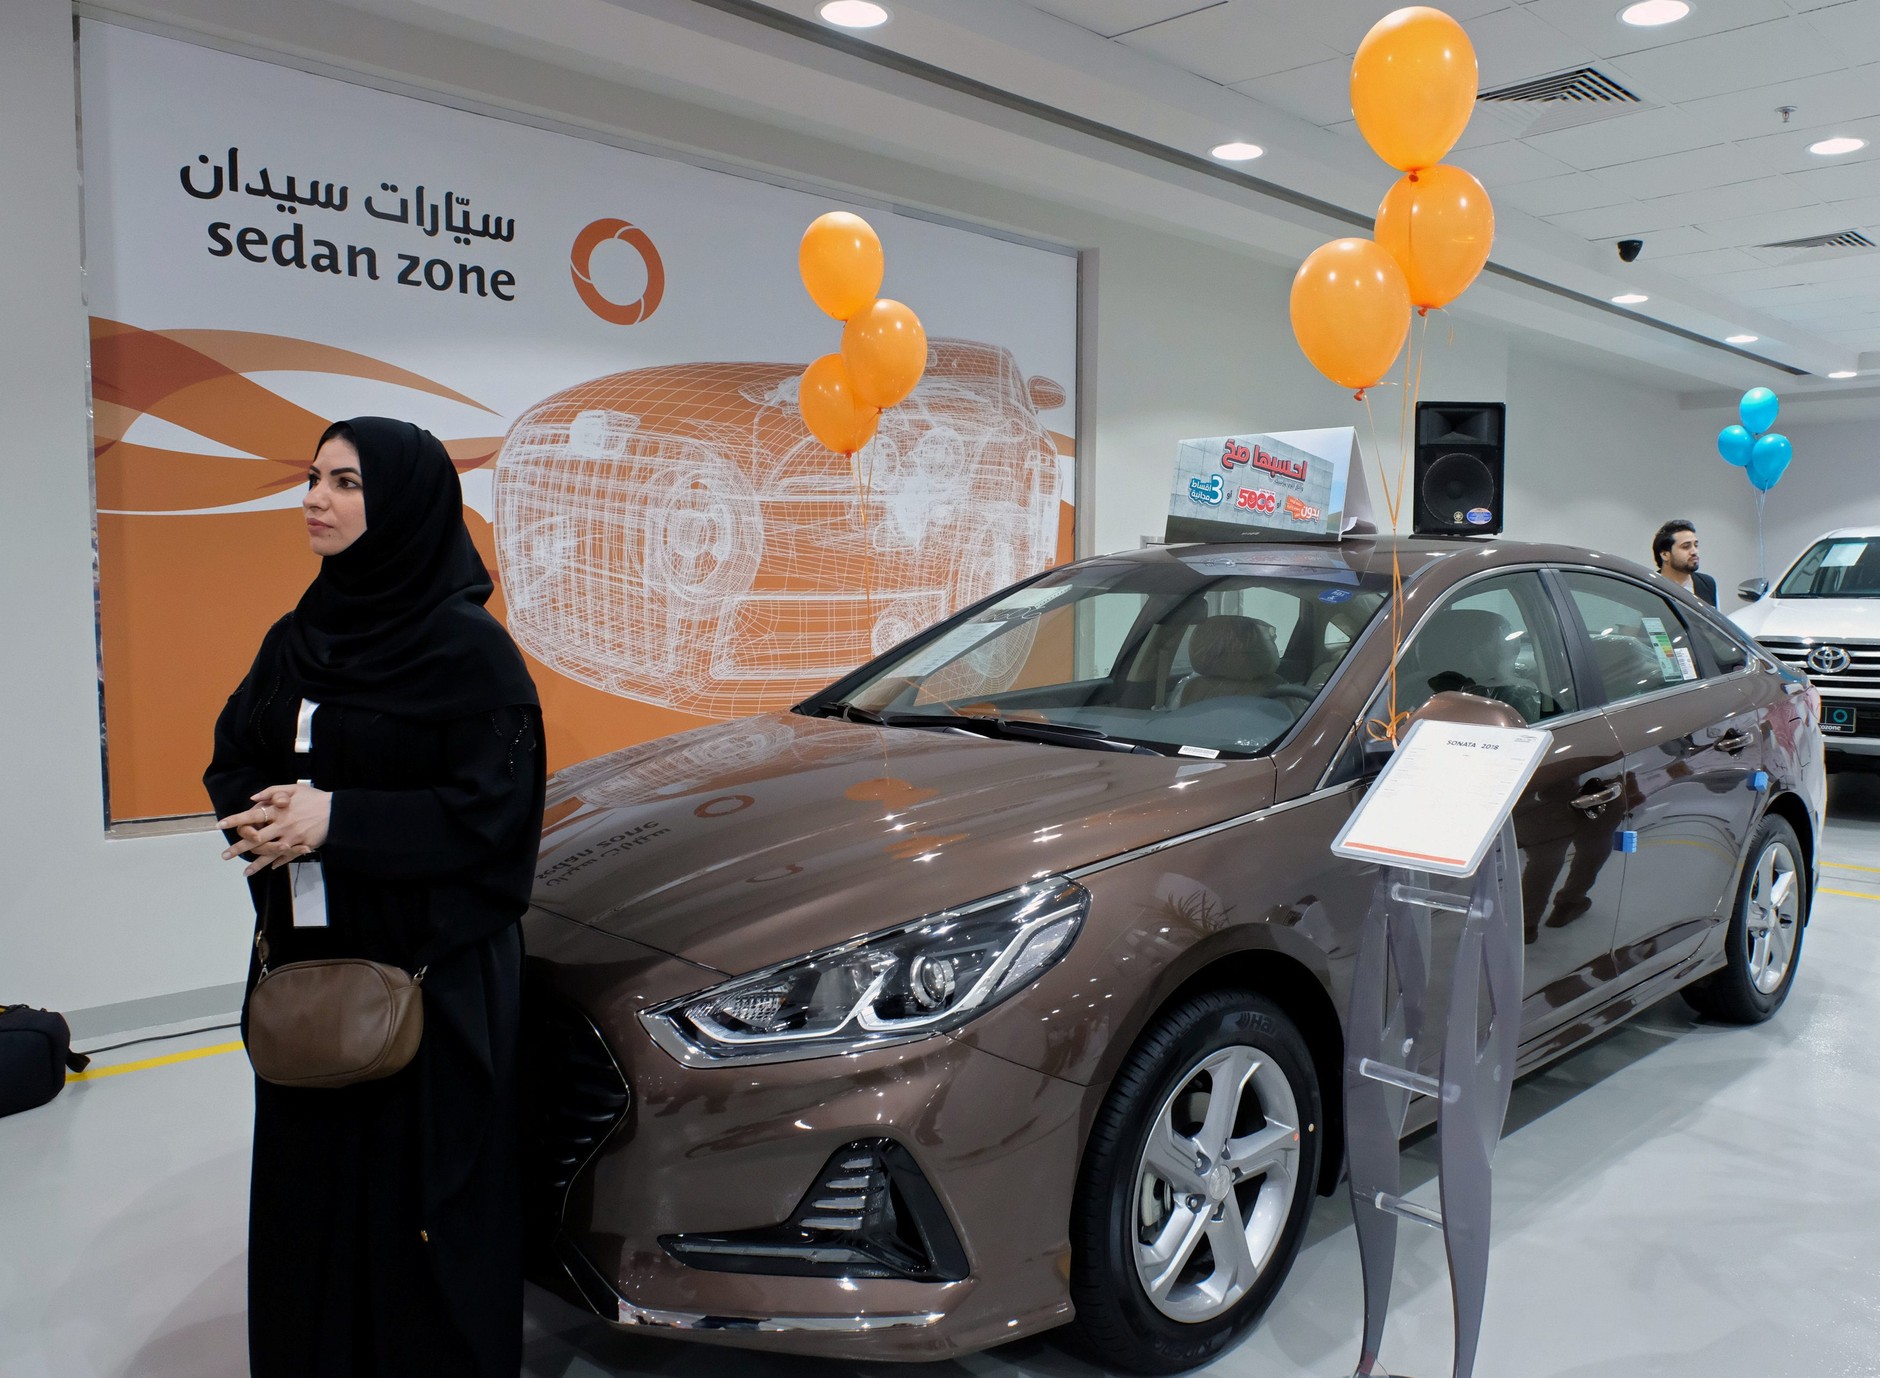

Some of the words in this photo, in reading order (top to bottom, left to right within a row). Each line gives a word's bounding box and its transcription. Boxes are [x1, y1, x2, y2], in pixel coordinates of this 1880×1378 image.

[180, 147, 349, 214] سيدان
[208, 222, 380, 280] sedan
[397, 253, 515, 301] zone
[1210, 475, 1223, 504] 3
[1237, 487, 1276, 513] 5000
[1300, 505, 1320, 521] بدون
[1446, 739, 1476, 748] SONATA
[1481, 743, 1500, 751] 2018
